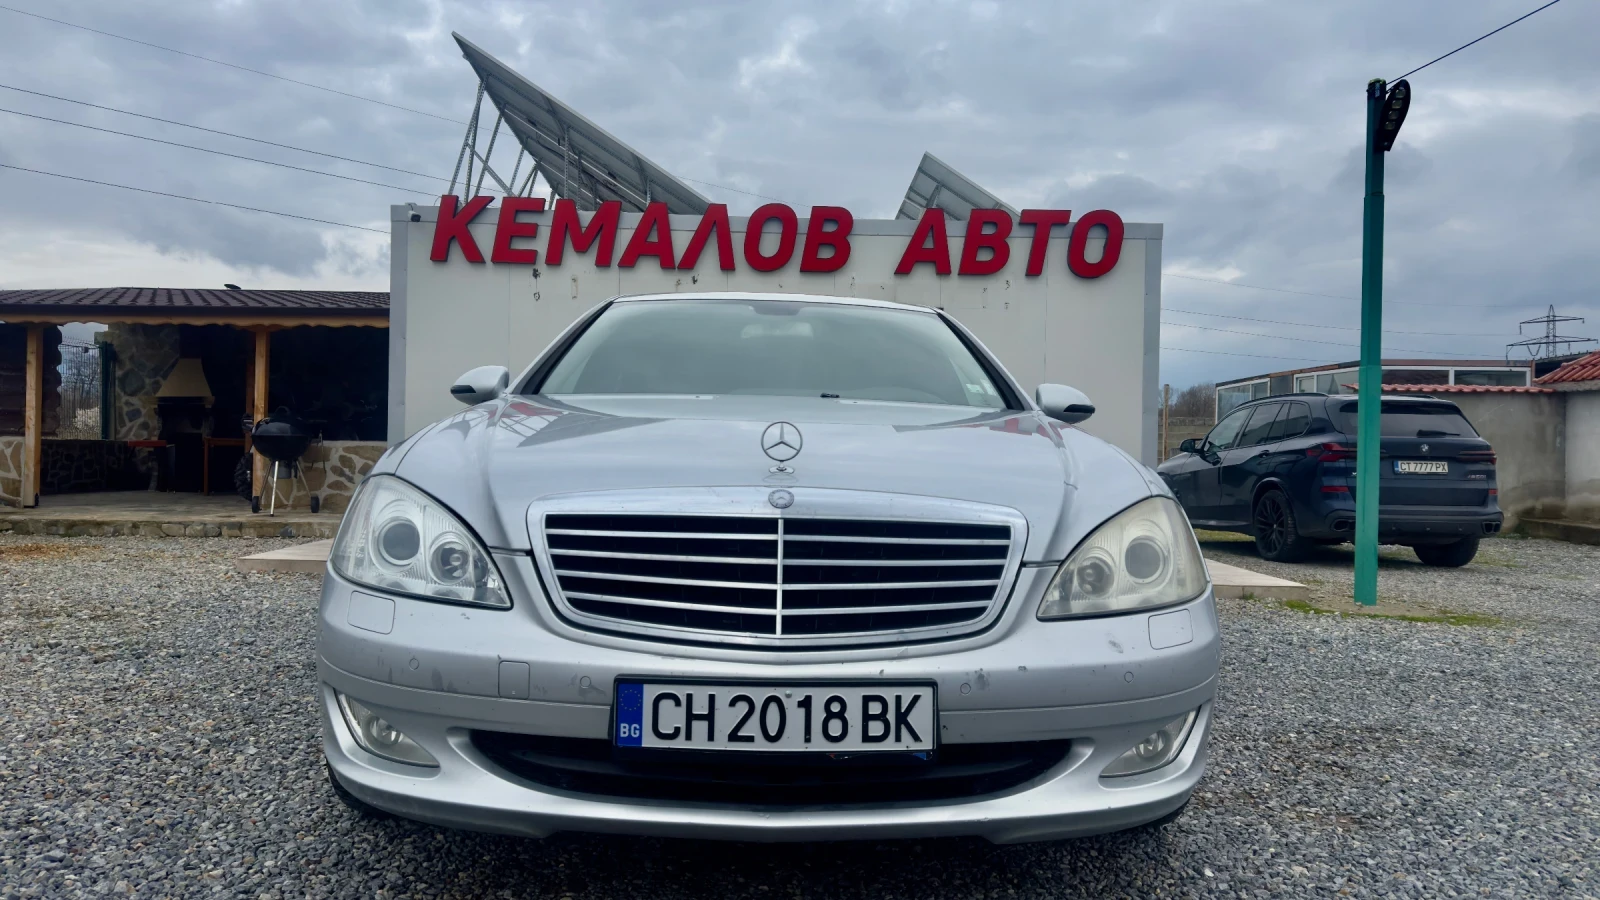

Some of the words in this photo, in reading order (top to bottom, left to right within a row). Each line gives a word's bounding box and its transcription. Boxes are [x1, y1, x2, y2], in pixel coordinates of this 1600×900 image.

[430, 194, 853, 274] КЕМАЛОВ
[894, 207, 1125, 279] АВТО
[620, 723, 640, 738] BG
[652, 692, 716, 742] CH
[727, 694, 849, 743] 2018
[861, 694, 923, 743] BK
